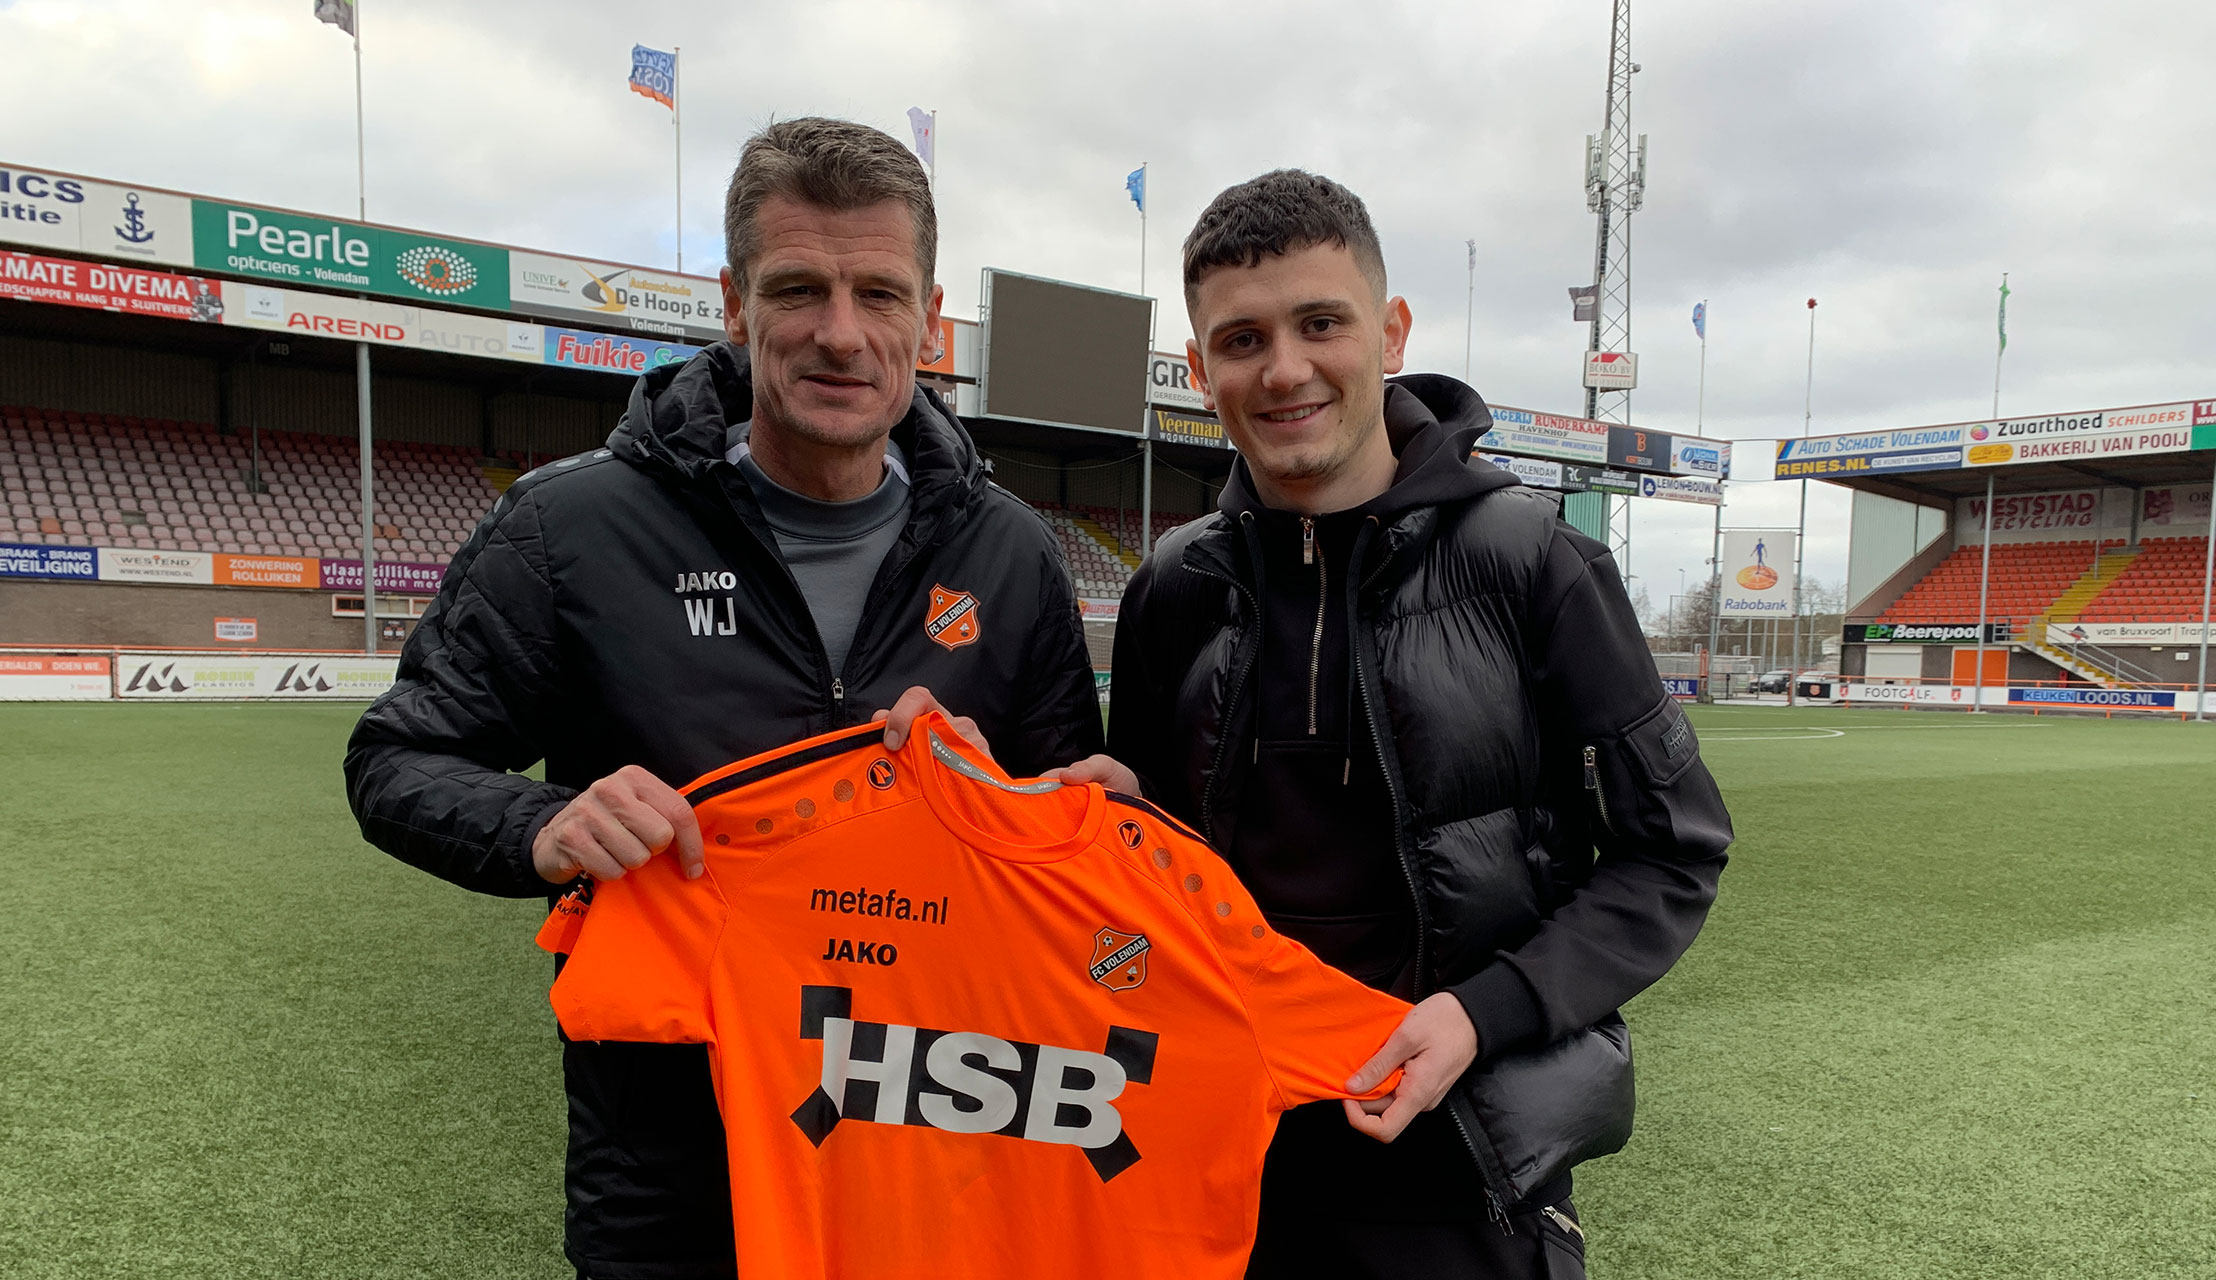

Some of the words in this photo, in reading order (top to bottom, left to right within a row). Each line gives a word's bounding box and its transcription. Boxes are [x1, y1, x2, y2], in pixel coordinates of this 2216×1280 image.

[227, 210, 370, 267] Pearle
[228, 255, 300, 276] opticiens
[314, 267, 370, 285] Volendam
[89, 268, 190, 301] DIVEMA
[75, 291, 107, 305] HANG
[112, 296, 127, 307] EN
[131, 299, 193, 316] SLUITWERK
[615, 287, 640, 307] De
[644, 292, 692, 319] Hoop
[287, 312, 405, 341] AREND
[419, 329, 505, 354] AUTO
[629, 318, 685, 336] Volendam
[555, 334, 647, 372] Fuikie
[1156, 410, 1223, 438] Veerman
[1518, 424, 1569, 438] HAVENHOF
[1535, 415, 1609, 435] RUNDERKAMP
[1997, 413, 2103, 437] Zwarthoed
[2107, 410, 2187, 428] SCHILDERS
[1159, 431, 1220, 447] WOONCENTRUM
[2020, 440, 2097, 459] BAKKERIJ
[2102, 437, 2133, 452] VAN
[2139, 432, 2188, 449] POOIJ
[1512, 463, 1557, 477] VOLENDAM
[1776, 458, 1871, 476] RENES.NL
[1920, 452, 1960, 464] RECYCLING
[1969, 493, 2096, 519] WESTSTAD
[49, 550, 92, 561] BRAND
[120, 556, 190, 566] WESTEND
[229, 559, 304, 572] ZONWERING
[232, 571, 301, 583] ROLLUIKEN
[326, 575, 407, 588] advoaten
[674, 571, 737, 594] JAKO
[684, 597, 737, 636] WJ
[928, 623, 940, 636] FC
[937, 596, 975, 628] VOLENDAM
[1724, 598, 1788, 611] Rabobank
[2096, 628, 2116, 636] van
[810, 887, 948, 925] metafa.nl
[822, 938, 898, 966] JAKO
[1091, 965, 1105, 979] FC
[1103, 937, 1149, 970] VOLENDAM
[820, 1016, 1128, 1149] HSB
